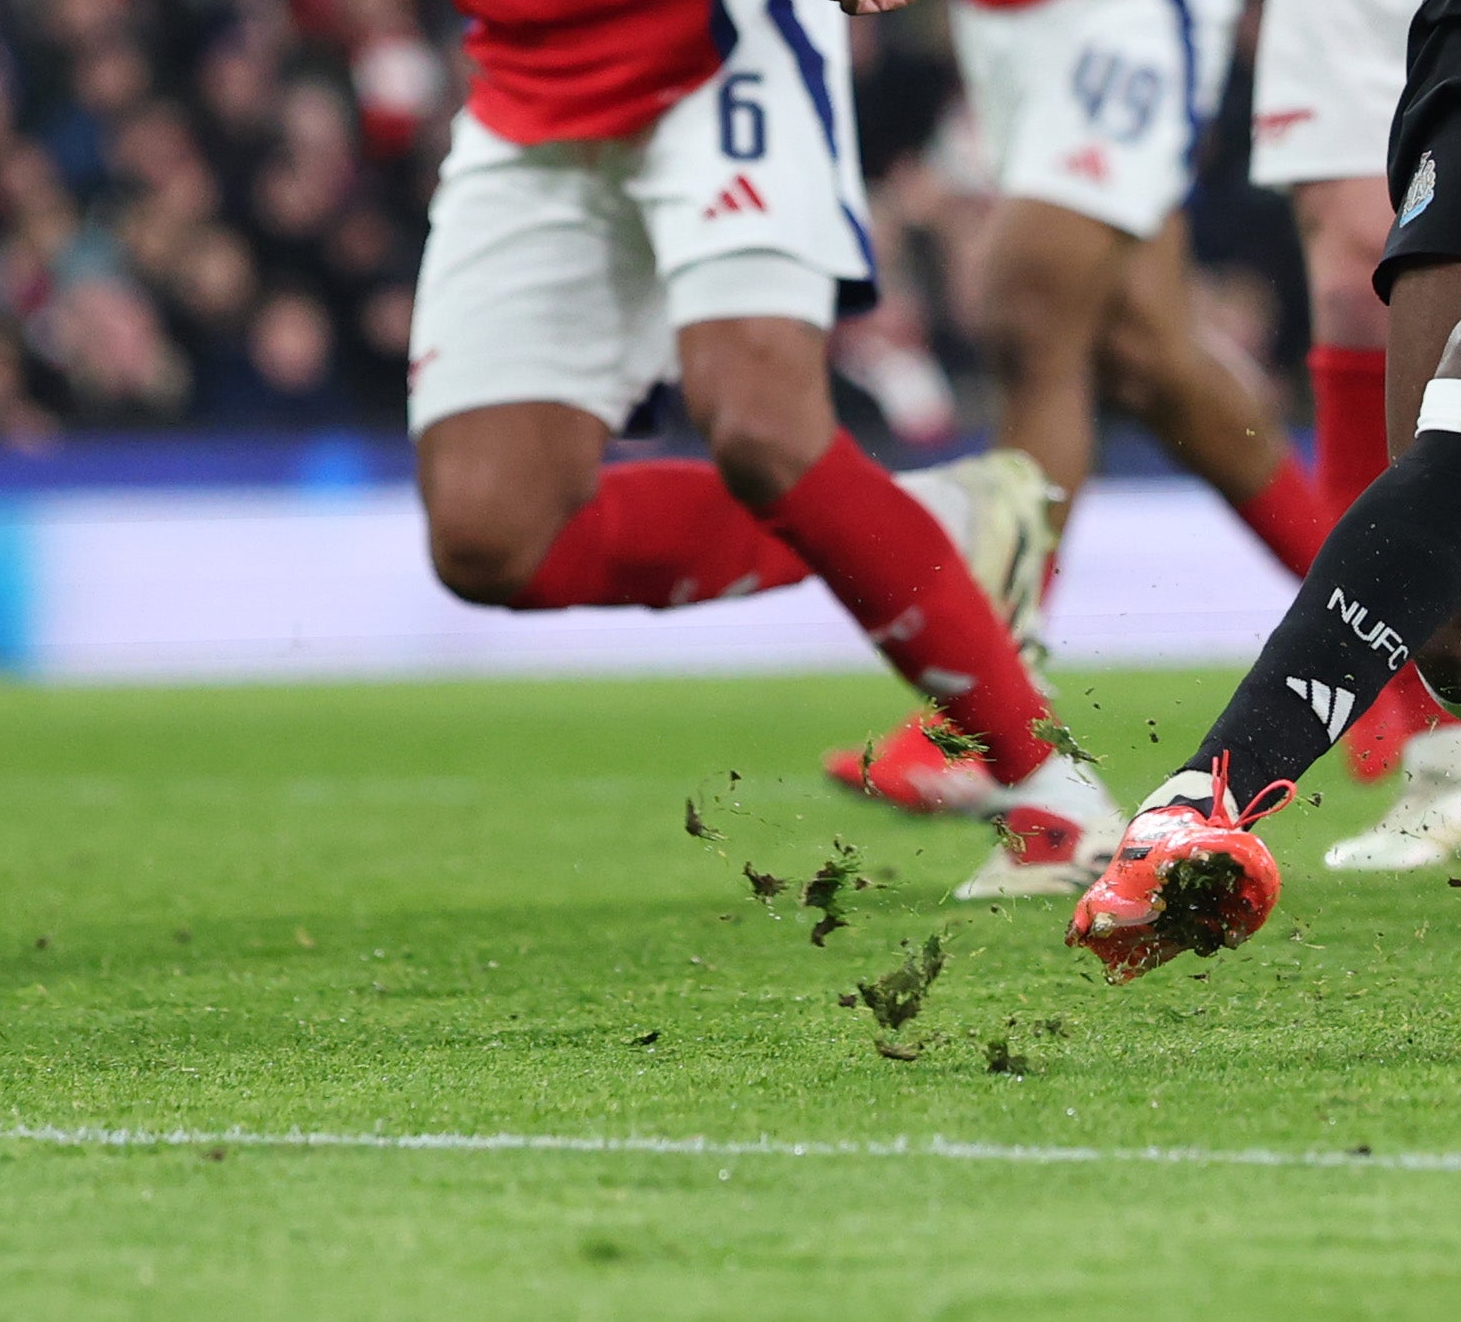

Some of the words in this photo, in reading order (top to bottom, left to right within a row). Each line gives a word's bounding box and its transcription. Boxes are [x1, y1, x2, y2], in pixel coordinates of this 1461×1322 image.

[719, 72, 766, 160] 6
[1073, 48, 1166, 143] 49
[1327, 587, 1409, 670] NUFC
